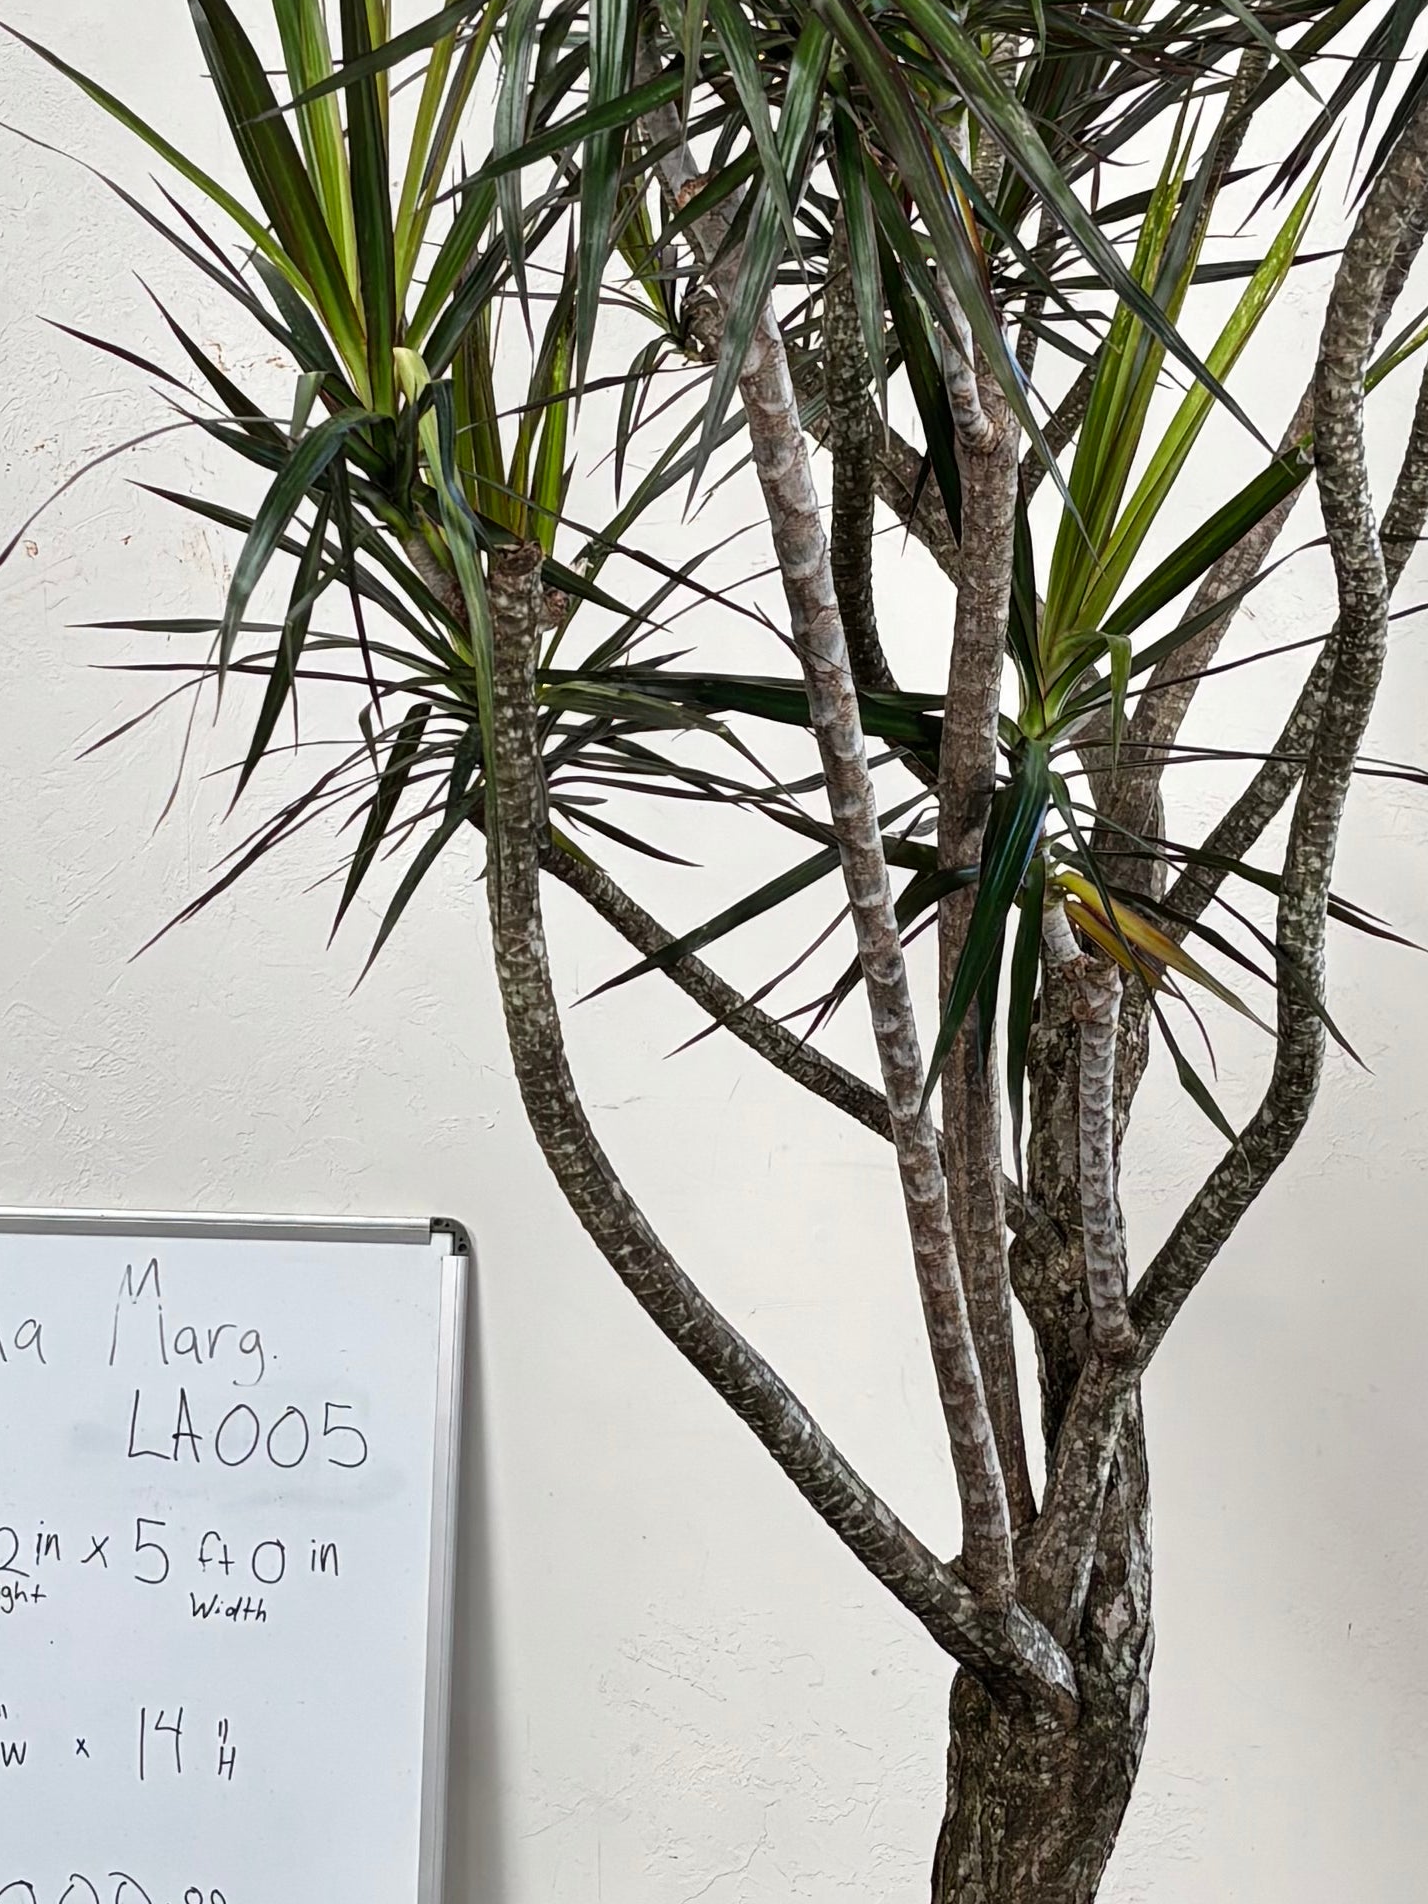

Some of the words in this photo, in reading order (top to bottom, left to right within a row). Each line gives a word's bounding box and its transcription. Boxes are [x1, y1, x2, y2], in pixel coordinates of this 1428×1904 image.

[128, 1388, 368, 1469] LA005
[134, 1518, 170, 1584] 5
[310, 1539, 340, 1578] in
[190, 1593, 269, 1624] Width
